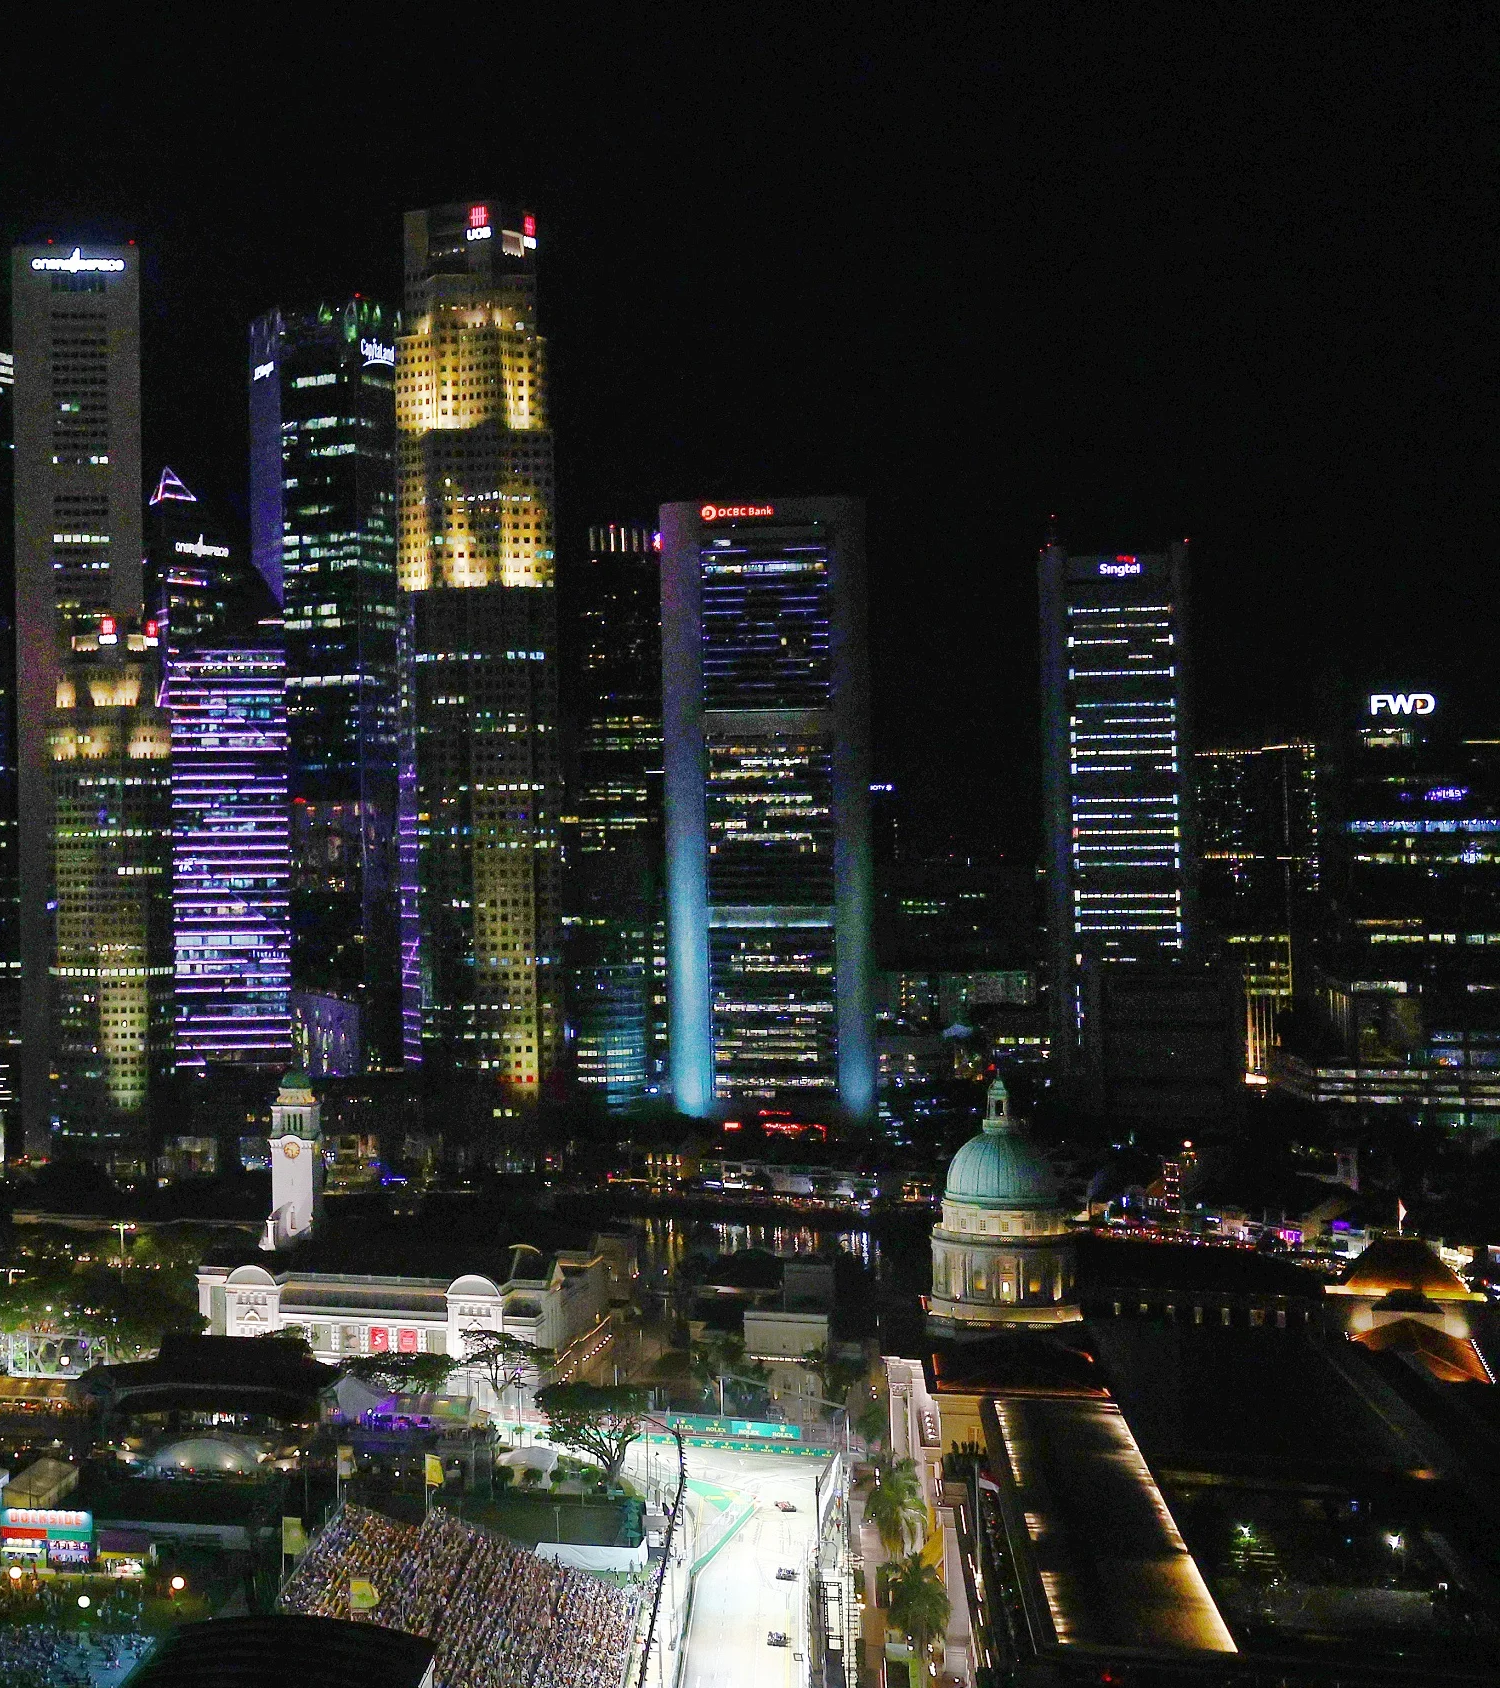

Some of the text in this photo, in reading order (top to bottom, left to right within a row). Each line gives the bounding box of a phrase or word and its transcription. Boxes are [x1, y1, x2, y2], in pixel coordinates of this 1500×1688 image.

[466, 226, 491, 241] UOB
[718, 505, 772, 517] OCBC Bank
[1100, 563, 1141, 577] Singtel
[1370, 693, 1435, 716] FWD
[705, 1426, 727, 1434] ROLEX
[738, 1429, 760, 1437] ROLEX
[771, 1431, 794, 1439] ROLEX
[9, 1511, 83, 1526] DOCKSIDE
